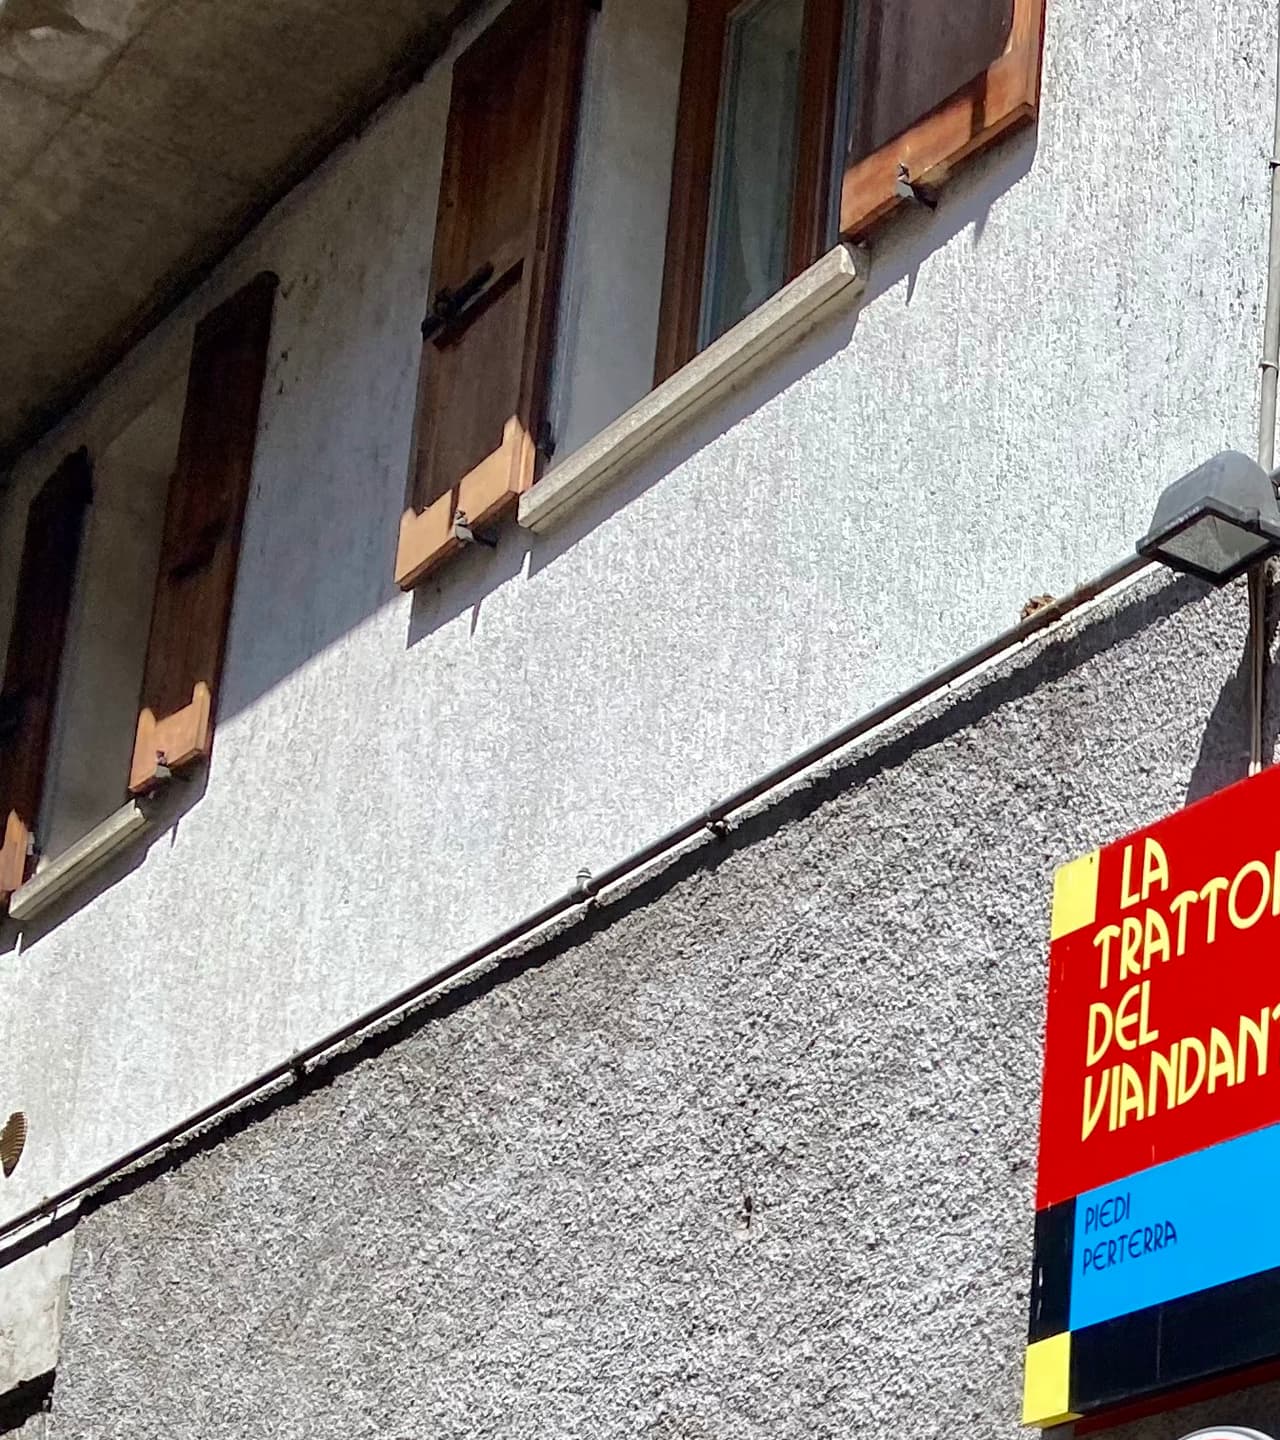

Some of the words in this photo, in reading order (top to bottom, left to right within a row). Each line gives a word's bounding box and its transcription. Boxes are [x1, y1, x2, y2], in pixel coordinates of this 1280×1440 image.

[1119, 836, 1169, 910] LA
[1086, 979, 1159, 1067] DEL
[1085, 1192, 1131, 1235] PIEDI
[1082, 1220, 1178, 1276] PERTERRA
